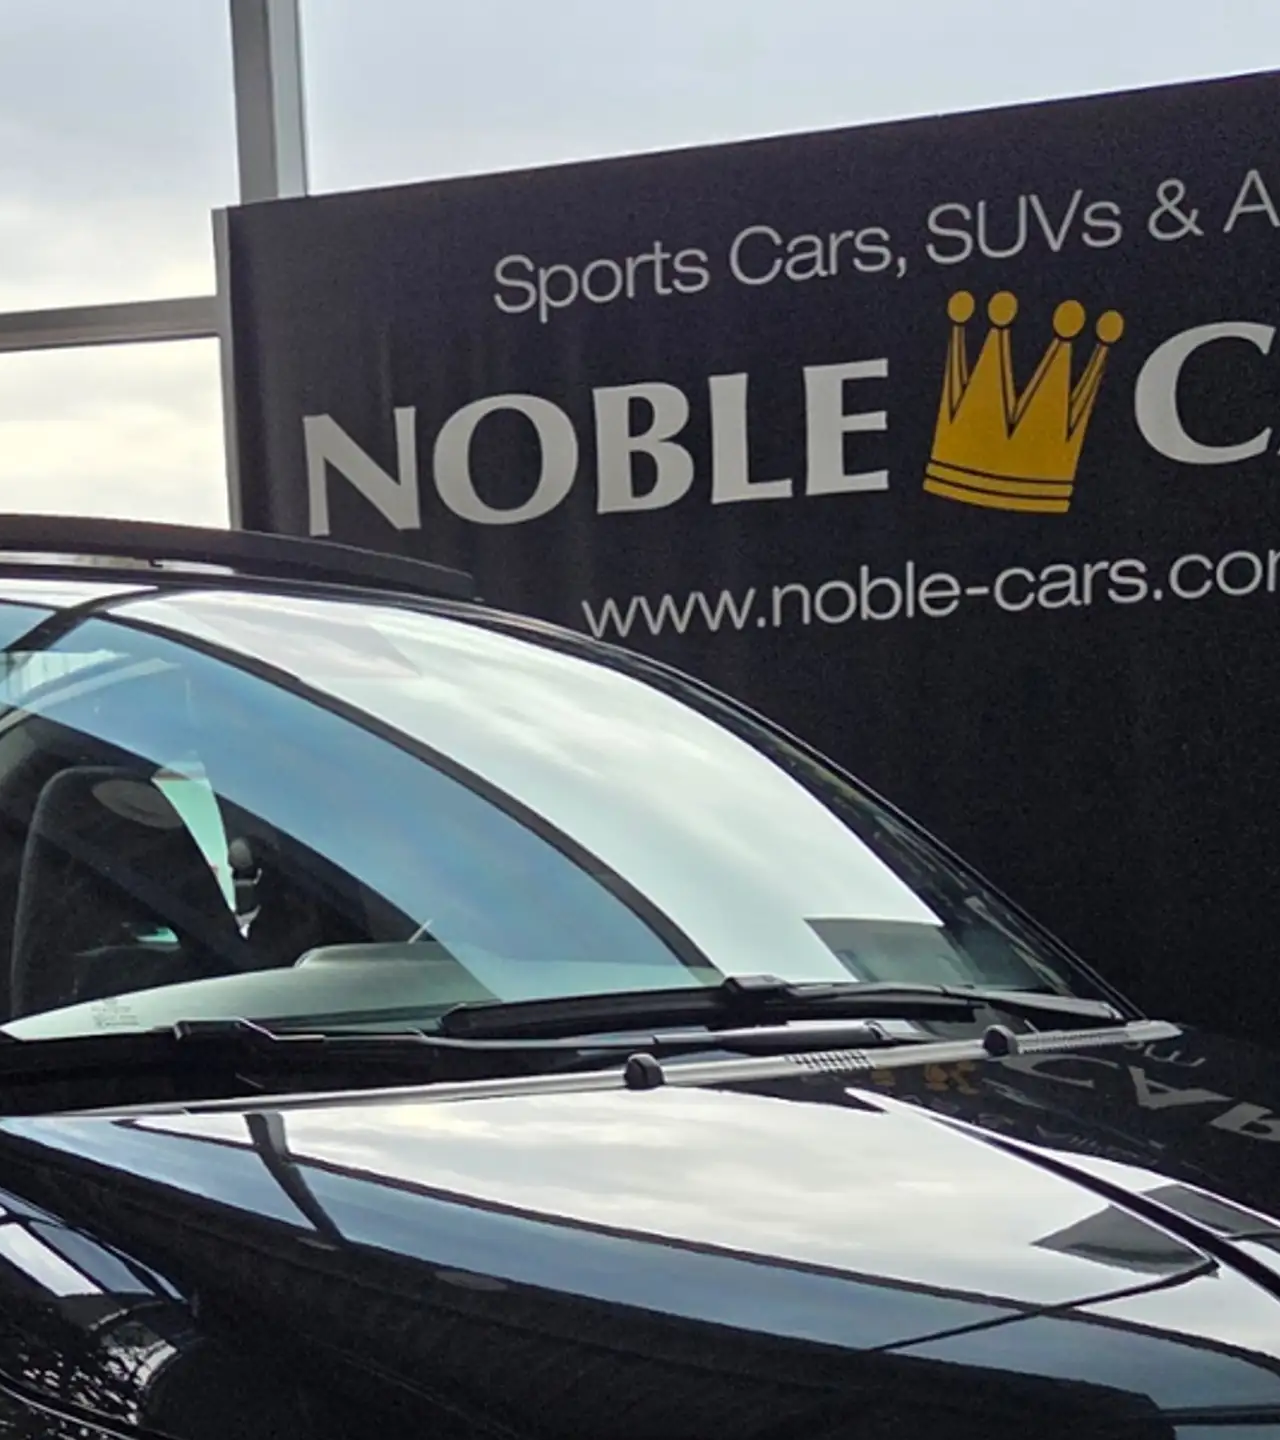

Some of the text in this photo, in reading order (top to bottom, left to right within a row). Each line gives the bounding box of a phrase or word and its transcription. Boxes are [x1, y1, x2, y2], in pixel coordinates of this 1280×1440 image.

[493, 240, 710, 324] Sports
[730, 225, 907, 286] Cars,
[924, 189, 1121, 265] SUVs
[1148, 178, 1204, 241] &
[302, 360, 889, 537] NOBLE
